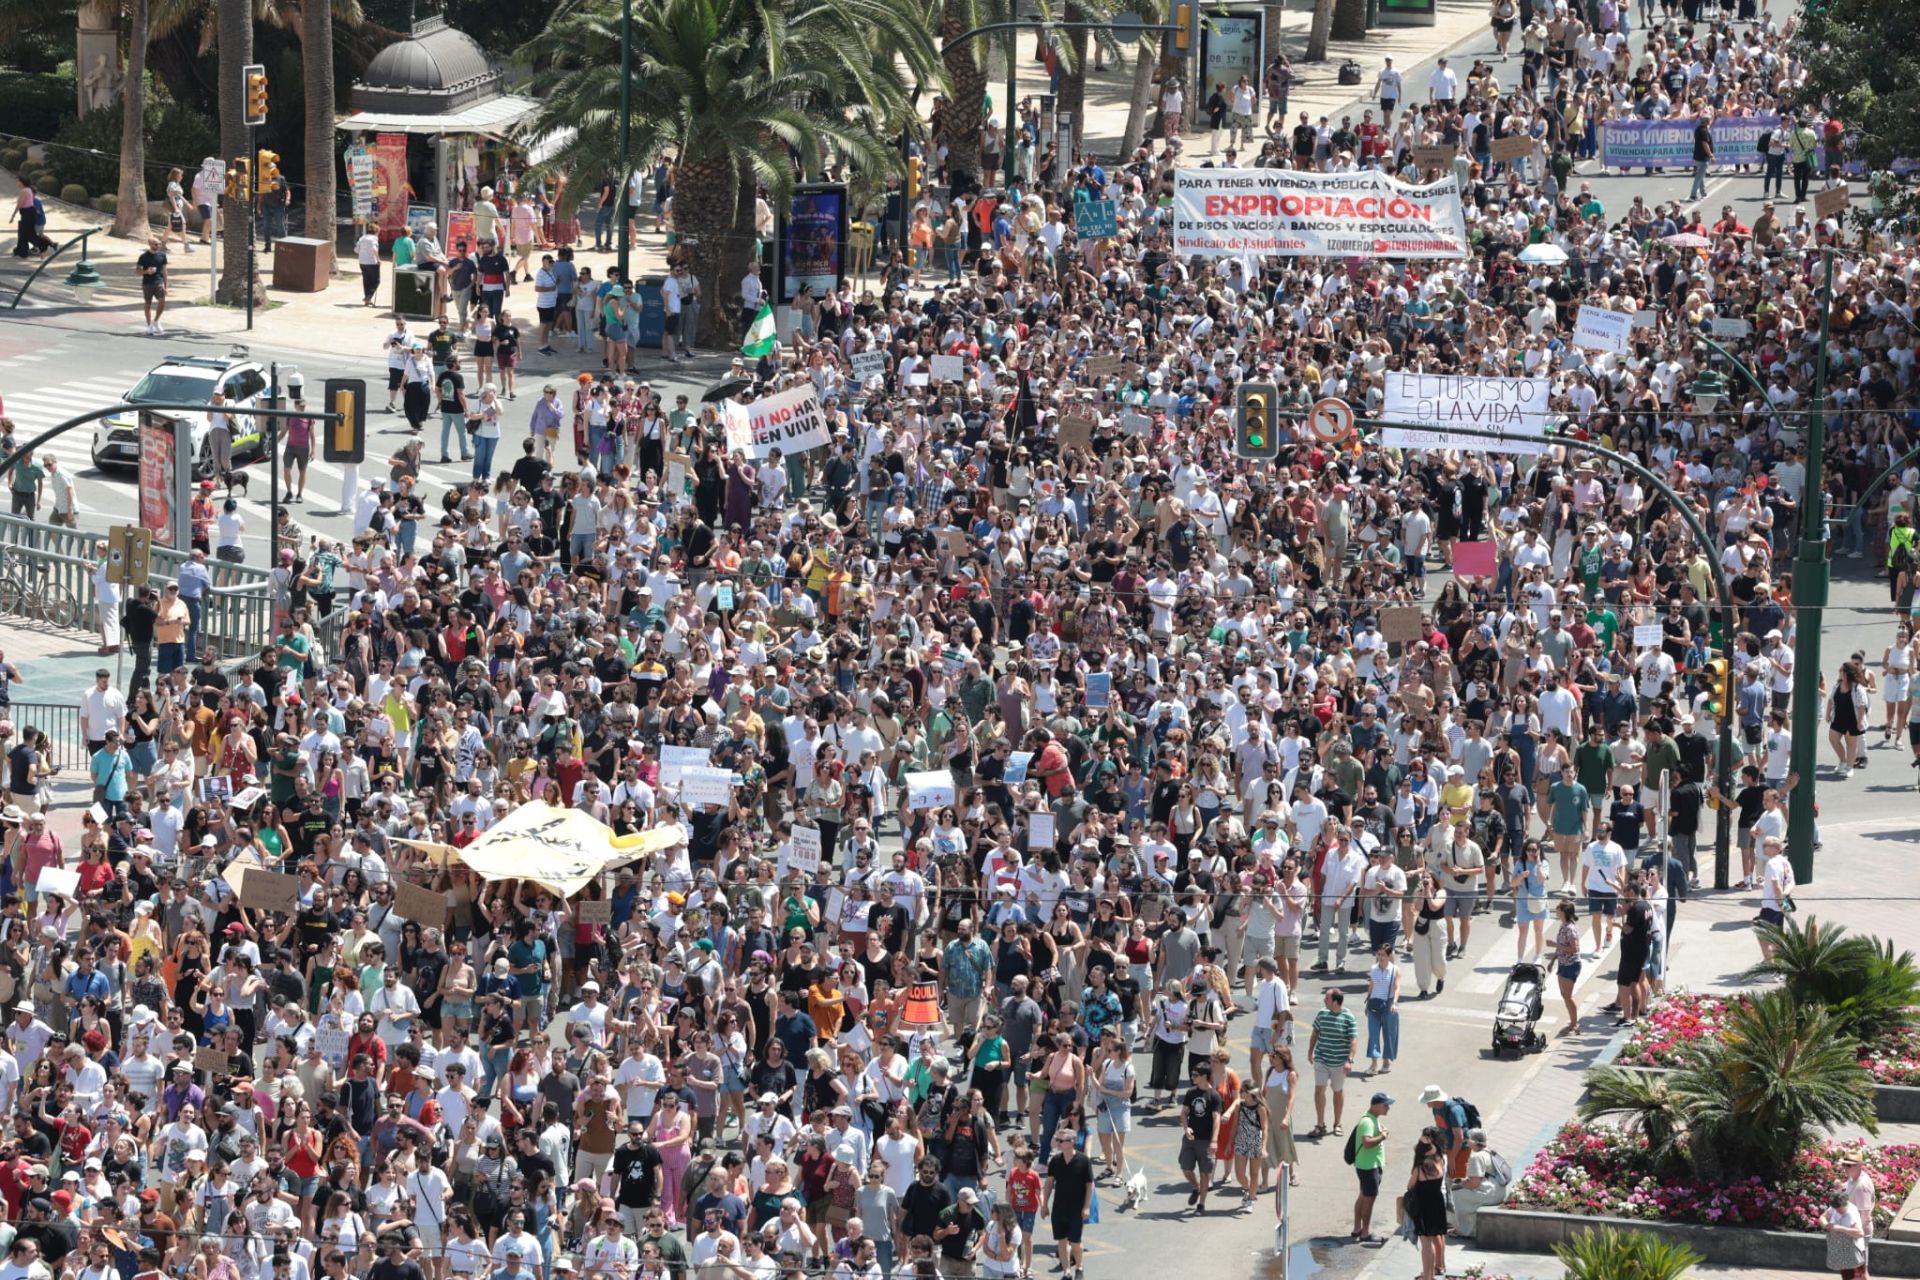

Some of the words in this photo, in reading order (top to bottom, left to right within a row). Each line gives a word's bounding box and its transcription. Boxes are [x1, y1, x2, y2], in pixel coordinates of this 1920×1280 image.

[1606, 129, 1639, 145] STOP
[1643, 129, 1695, 145] VIVIEND
[1609, 147, 1650, 156] VIVIENDAS
[1653, 147, 1674, 156] PARA
[1718, 145, 1739, 153] PARA
[1179, 179, 1212, 188] PARA
[1217, 179, 1253, 188] TENER
[1258, 179, 1317, 189] VIVIENDA
[1323, 178, 1380, 190] PÚBLICA
[1397, 185, 1457, 198] ACCESIBLE
[1205, 195, 1431, 222] EXPROPIACIÓN
[1179, 221, 1192, 230] DE
[1197, 221, 1228, 230] PISOS
[1232, 220, 1274, 230] VACÍOS
[1278, 222, 1286, 230] A
[1291, 222, 1342, 231] BANCOS
[1346, 222, 1355, 231] Y
[1178, 237, 1225, 249] Sindicato
[1228, 238, 1240, 249] de
[1244, 238, 1306, 250] Estudiantes
[1328, 240, 1375, 252] IZQUIERDA
[1402, 374, 1432, 399] EL
[1435, 376, 1535, 402] TURISMO
[769, 408, 791, 426] NO
[793, 397, 817, 417] HAY
[1417, 400, 1432, 420] O
[1437, 400, 1463, 421] LA
[1467, 402, 1523, 424] VIDA
[785, 415, 821, 438] VIVA
[1439, 434, 1448, 443] NI
[1586, 562, 1599, 574] 20
